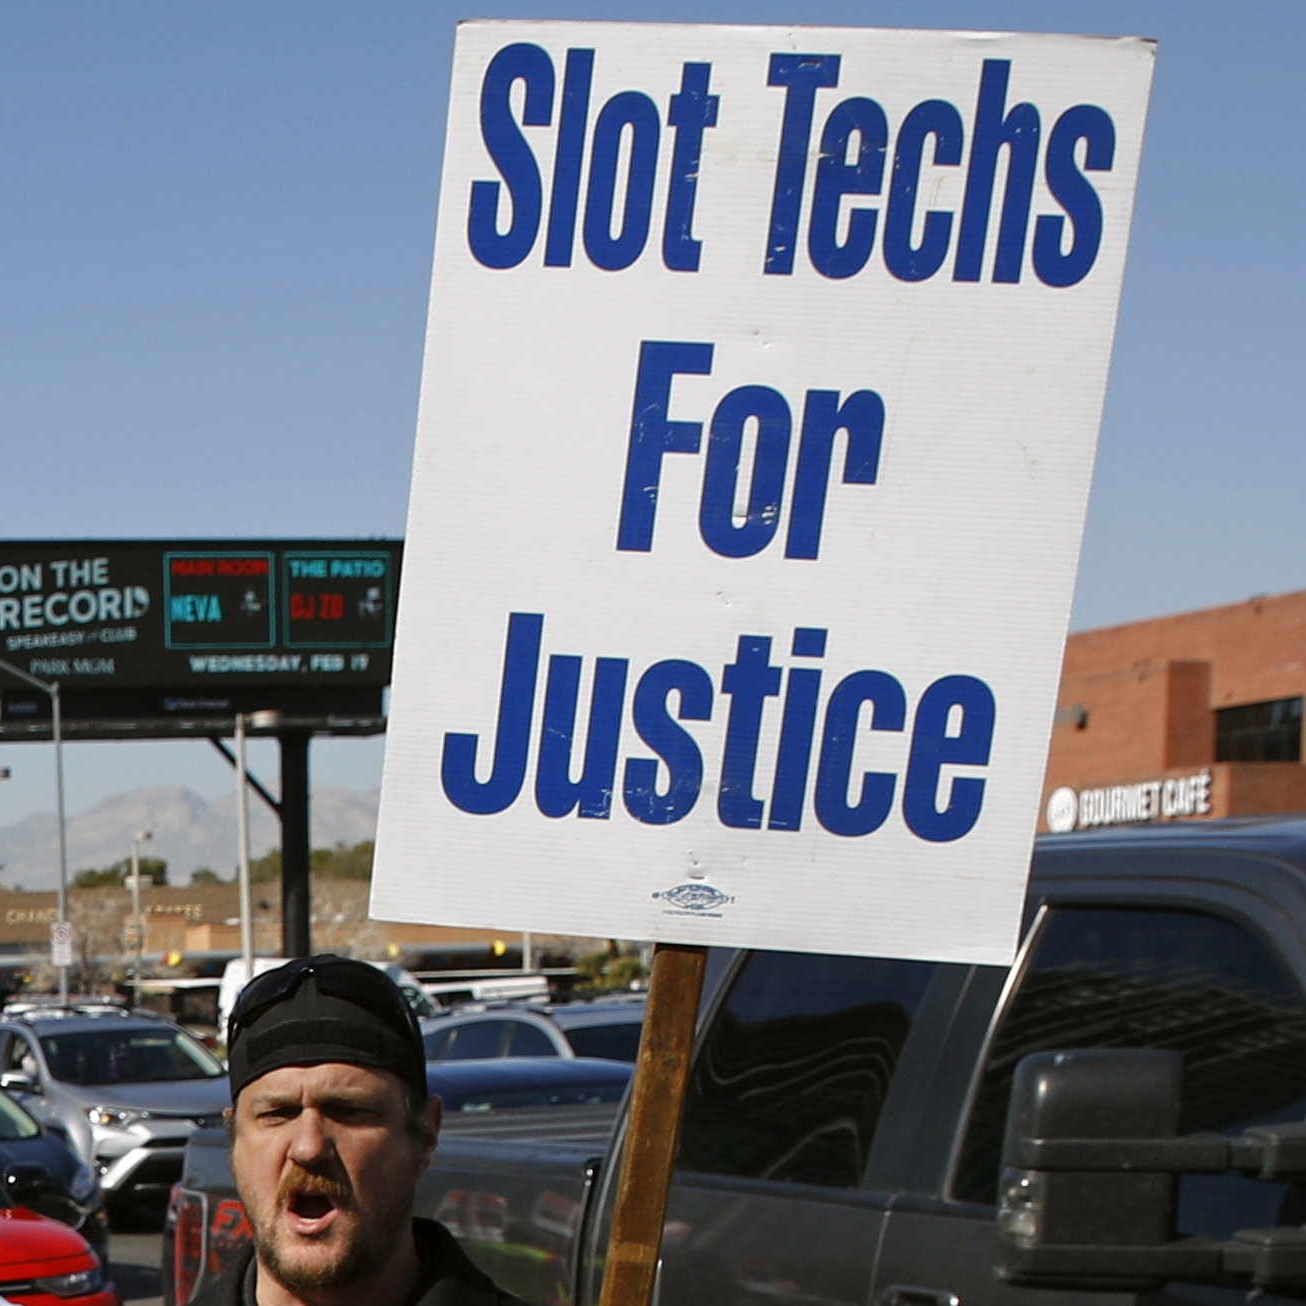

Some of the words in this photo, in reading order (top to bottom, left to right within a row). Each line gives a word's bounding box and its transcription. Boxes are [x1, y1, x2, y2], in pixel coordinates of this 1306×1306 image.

[468, 43, 720, 272] Slot
[763, 53, 1117, 289] Techs
[616, 340, 885, 562] For
[49, 557, 109, 588] THE
[170, 595, 222, 622] NEVA
[330, 560, 385, 578] PATIO
[440, 612, 996, 843] Justice
